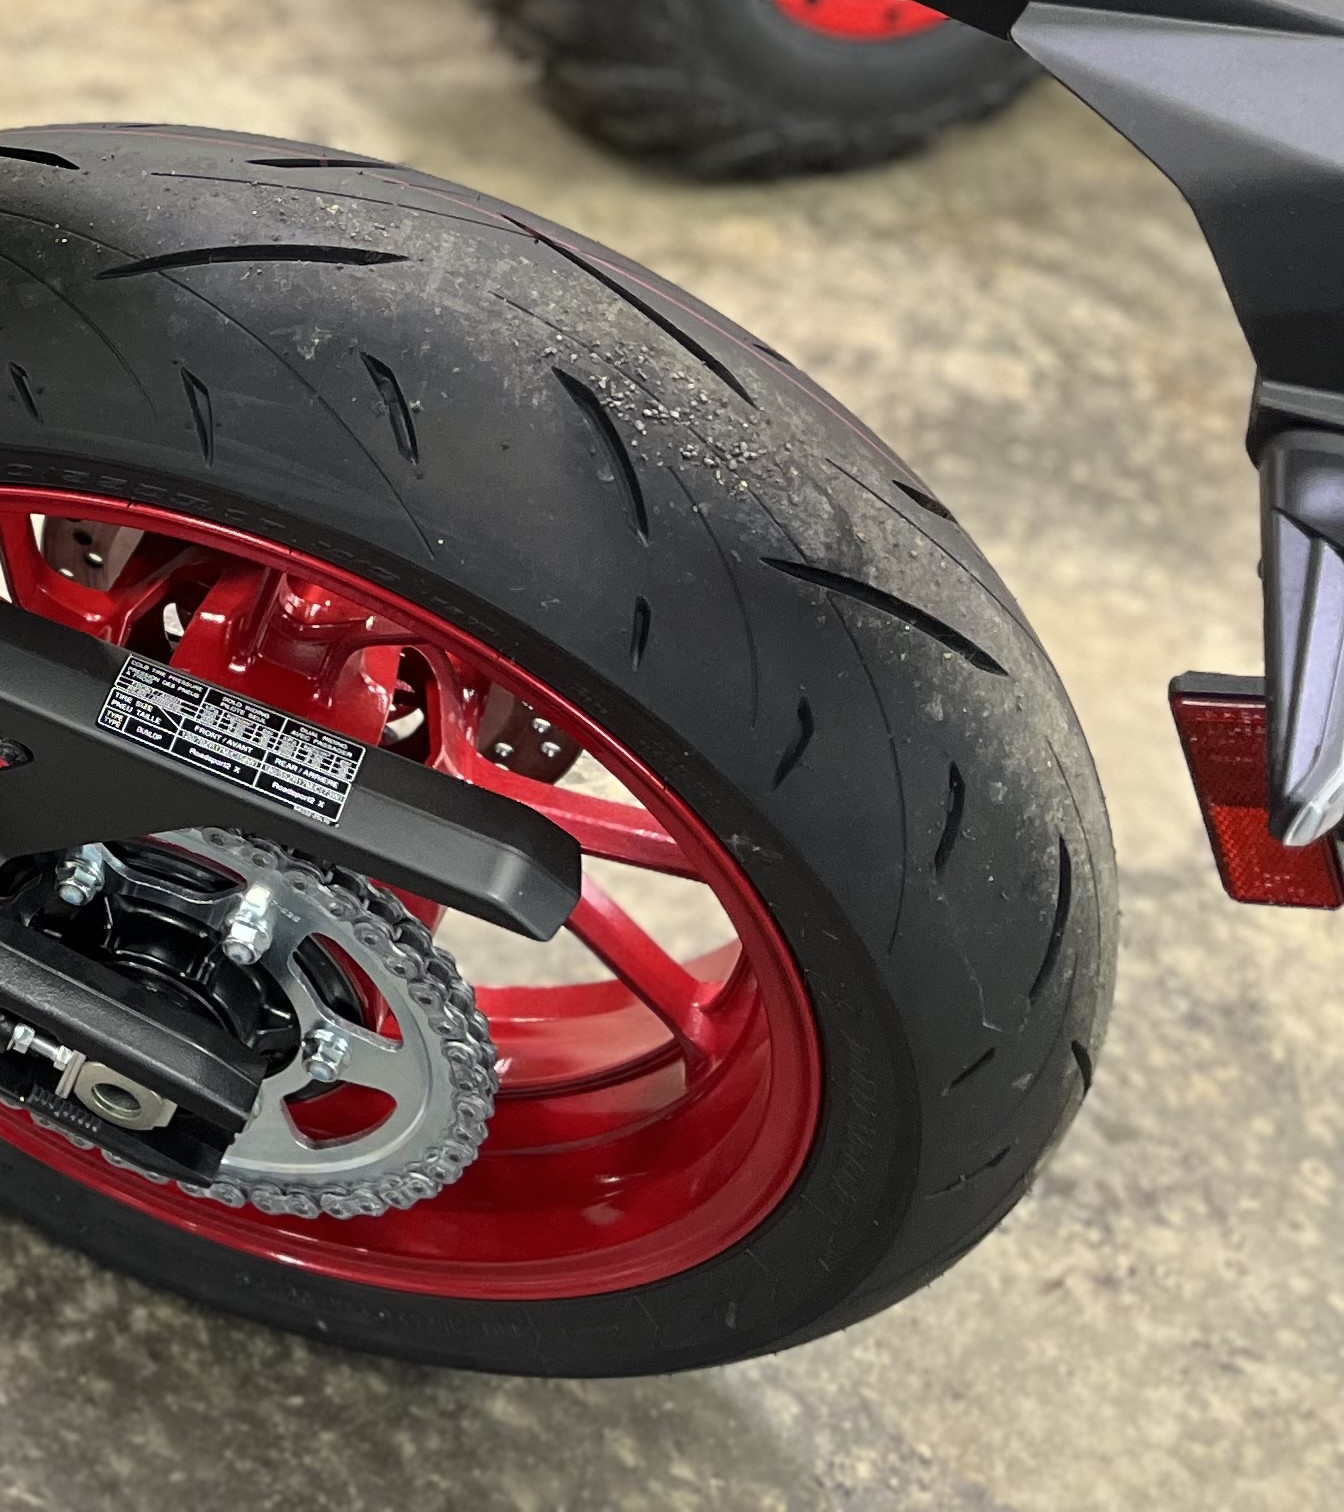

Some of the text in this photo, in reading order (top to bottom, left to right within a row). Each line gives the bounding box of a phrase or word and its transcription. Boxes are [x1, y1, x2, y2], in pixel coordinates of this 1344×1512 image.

[113, 690, 134, 704] TIRE
[109, 697, 163, 725] PNEU TAILLE
[192, 723, 223, 742] FRONT
[225, 737, 253, 754] AVANT
[272, 755, 299, 773] REAR
